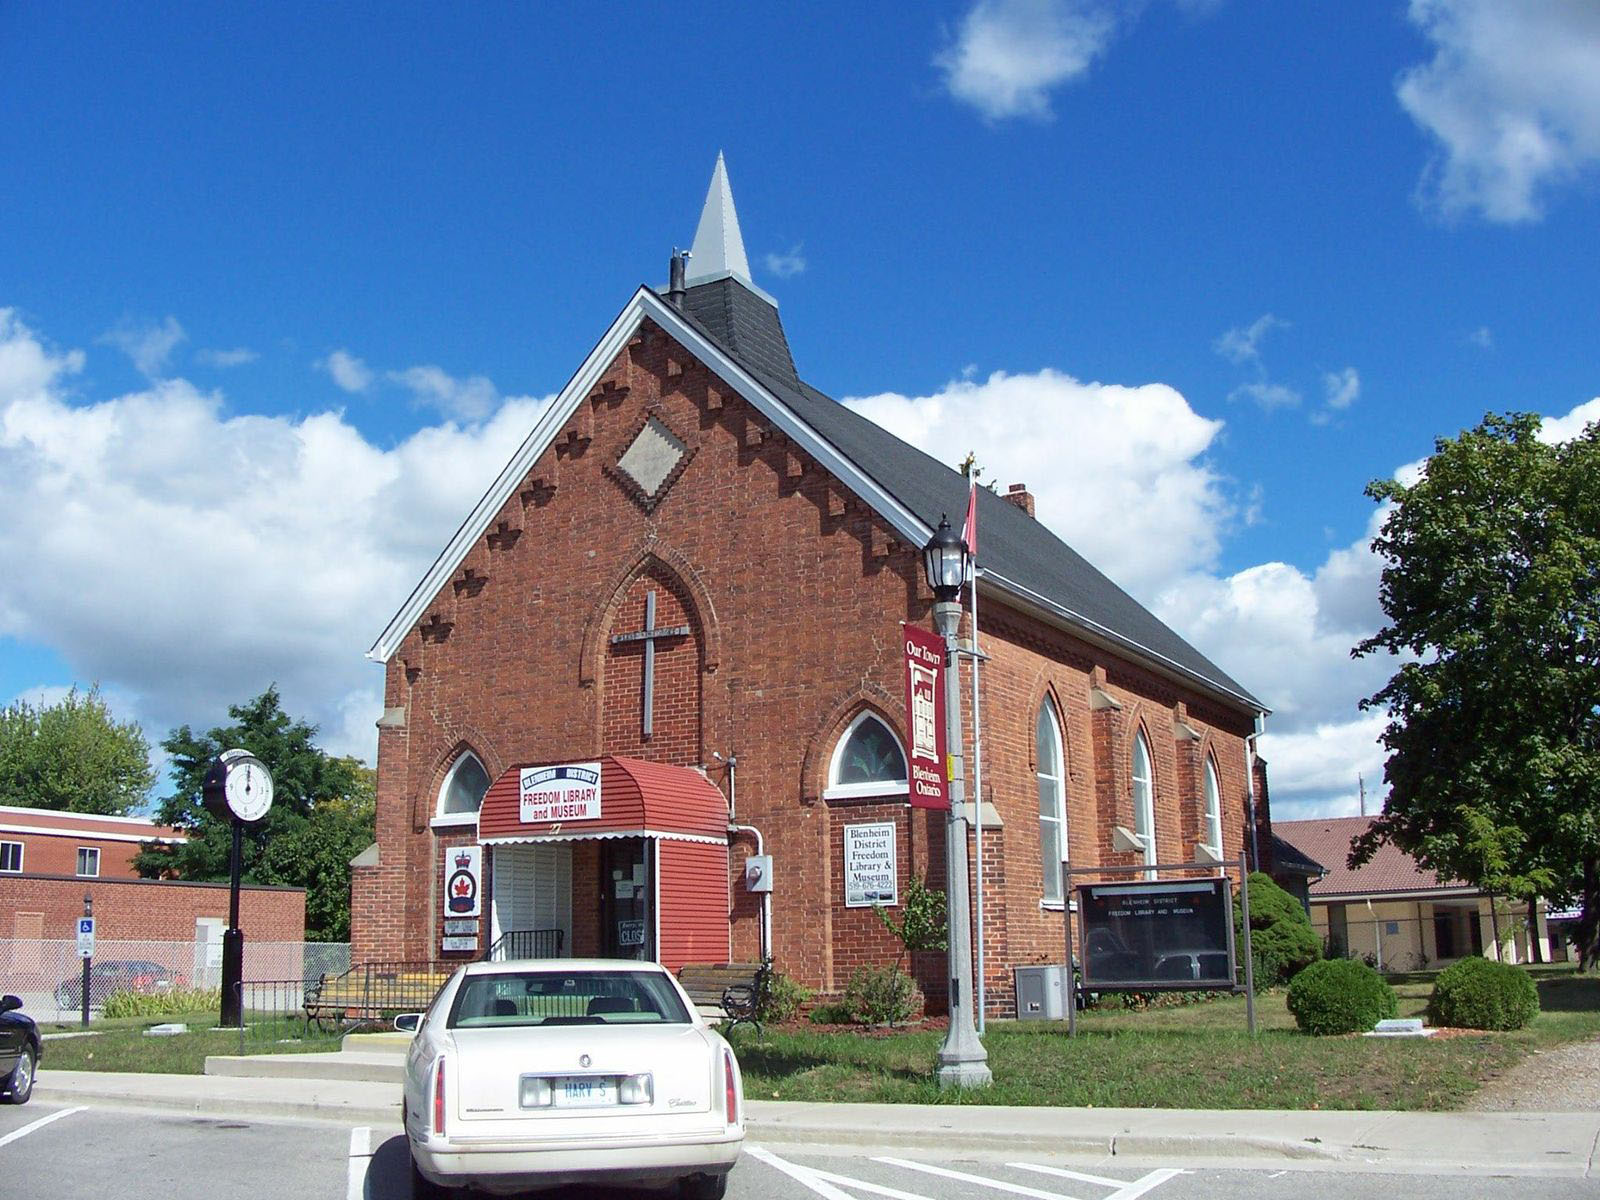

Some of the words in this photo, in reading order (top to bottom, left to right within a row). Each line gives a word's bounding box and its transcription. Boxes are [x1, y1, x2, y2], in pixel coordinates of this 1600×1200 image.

[907, 640, 922, 658] Our
[922, 645, 941, 665] Town
[566, 768, 598, 784] DISTRICT
[523, 790, 561, 806] FREEDOM
[563, 787, 597, 803] LIBRARY
[533, 807, 548, 819] and
[551, 804, 587, 819] MUSEUM
[850, 828, 890, 839] Blenheim
[854, 840, 886, 849] District
[852, 851, 889, 860] Freedom
[850, 861, 881, 872] Library
[884, 861, 892, 870] &
[853, 873, 889, 882] Museum
[621, 930, 643, 942] CLOS
[599, 1082, 606, 1097] S
